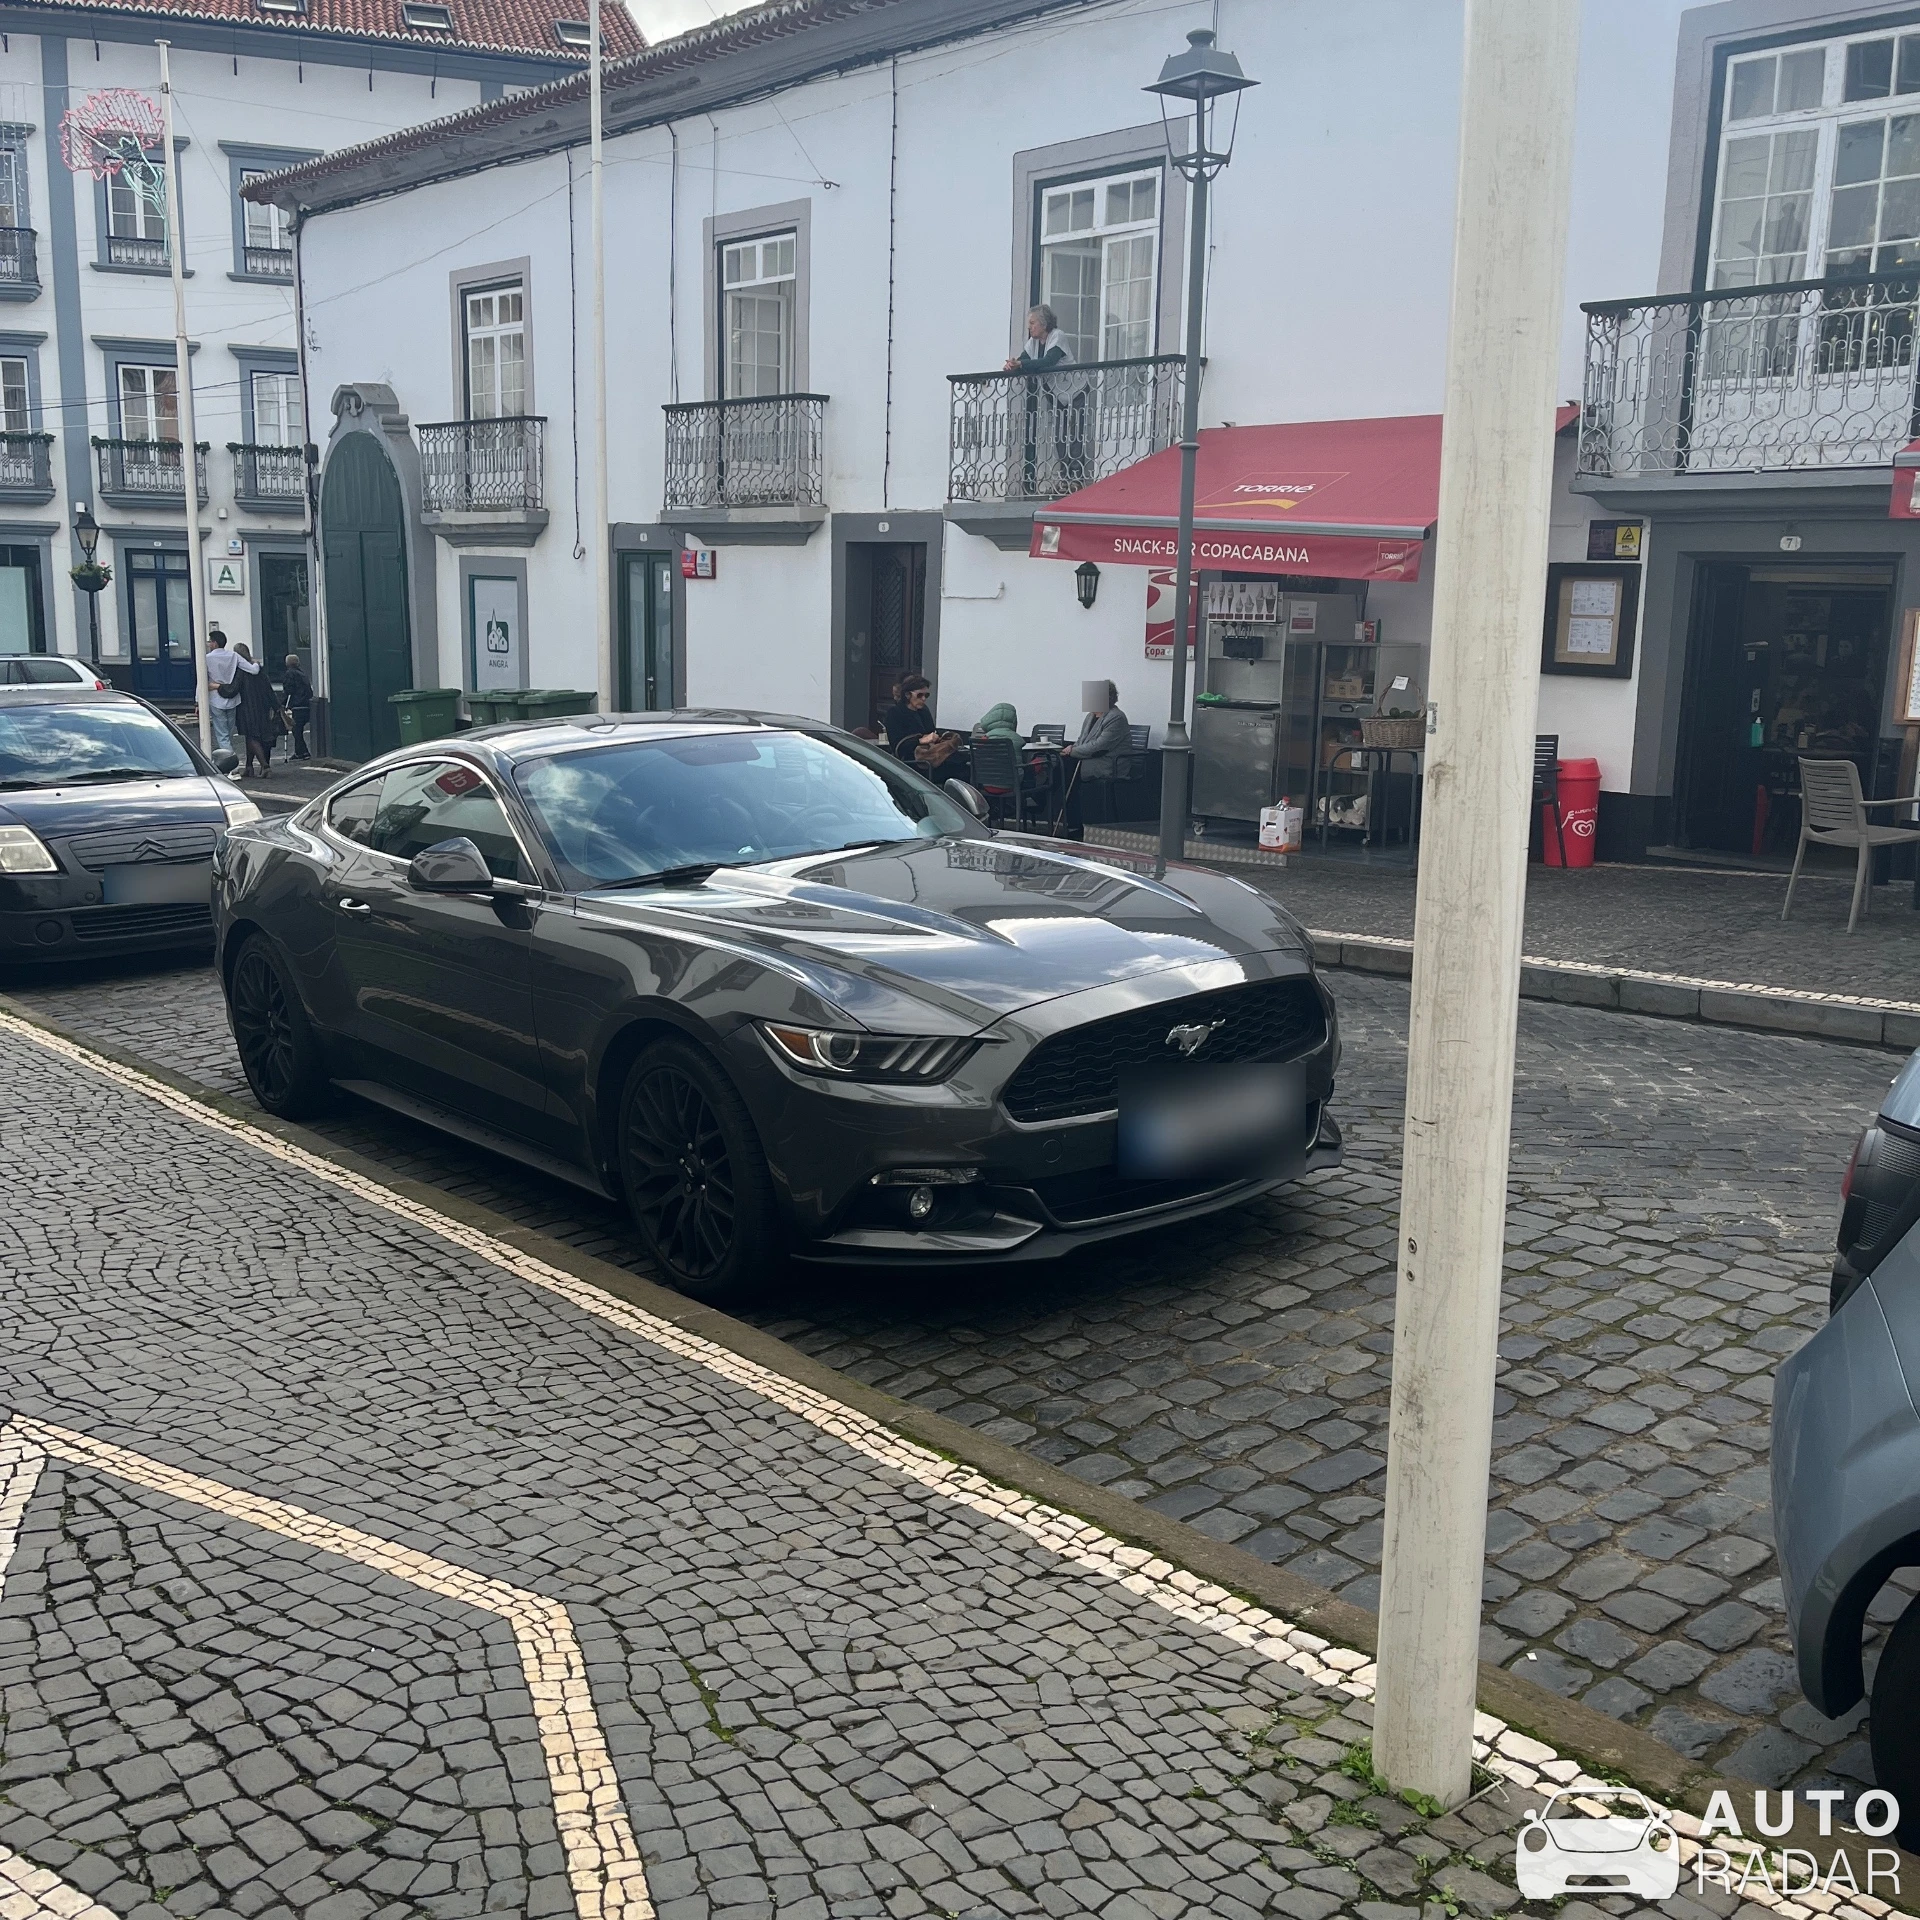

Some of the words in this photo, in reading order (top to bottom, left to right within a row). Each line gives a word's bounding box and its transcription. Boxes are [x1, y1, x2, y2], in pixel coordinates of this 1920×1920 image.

[1113, 538, 1196, 557] SNACK-BR
[1200, 543, 1310, 563] COPACABANA
[1786, 537, 1794, 549] 7
[218, 565, 236, 584] A
[488, 659, 509, 669] ANGRA
